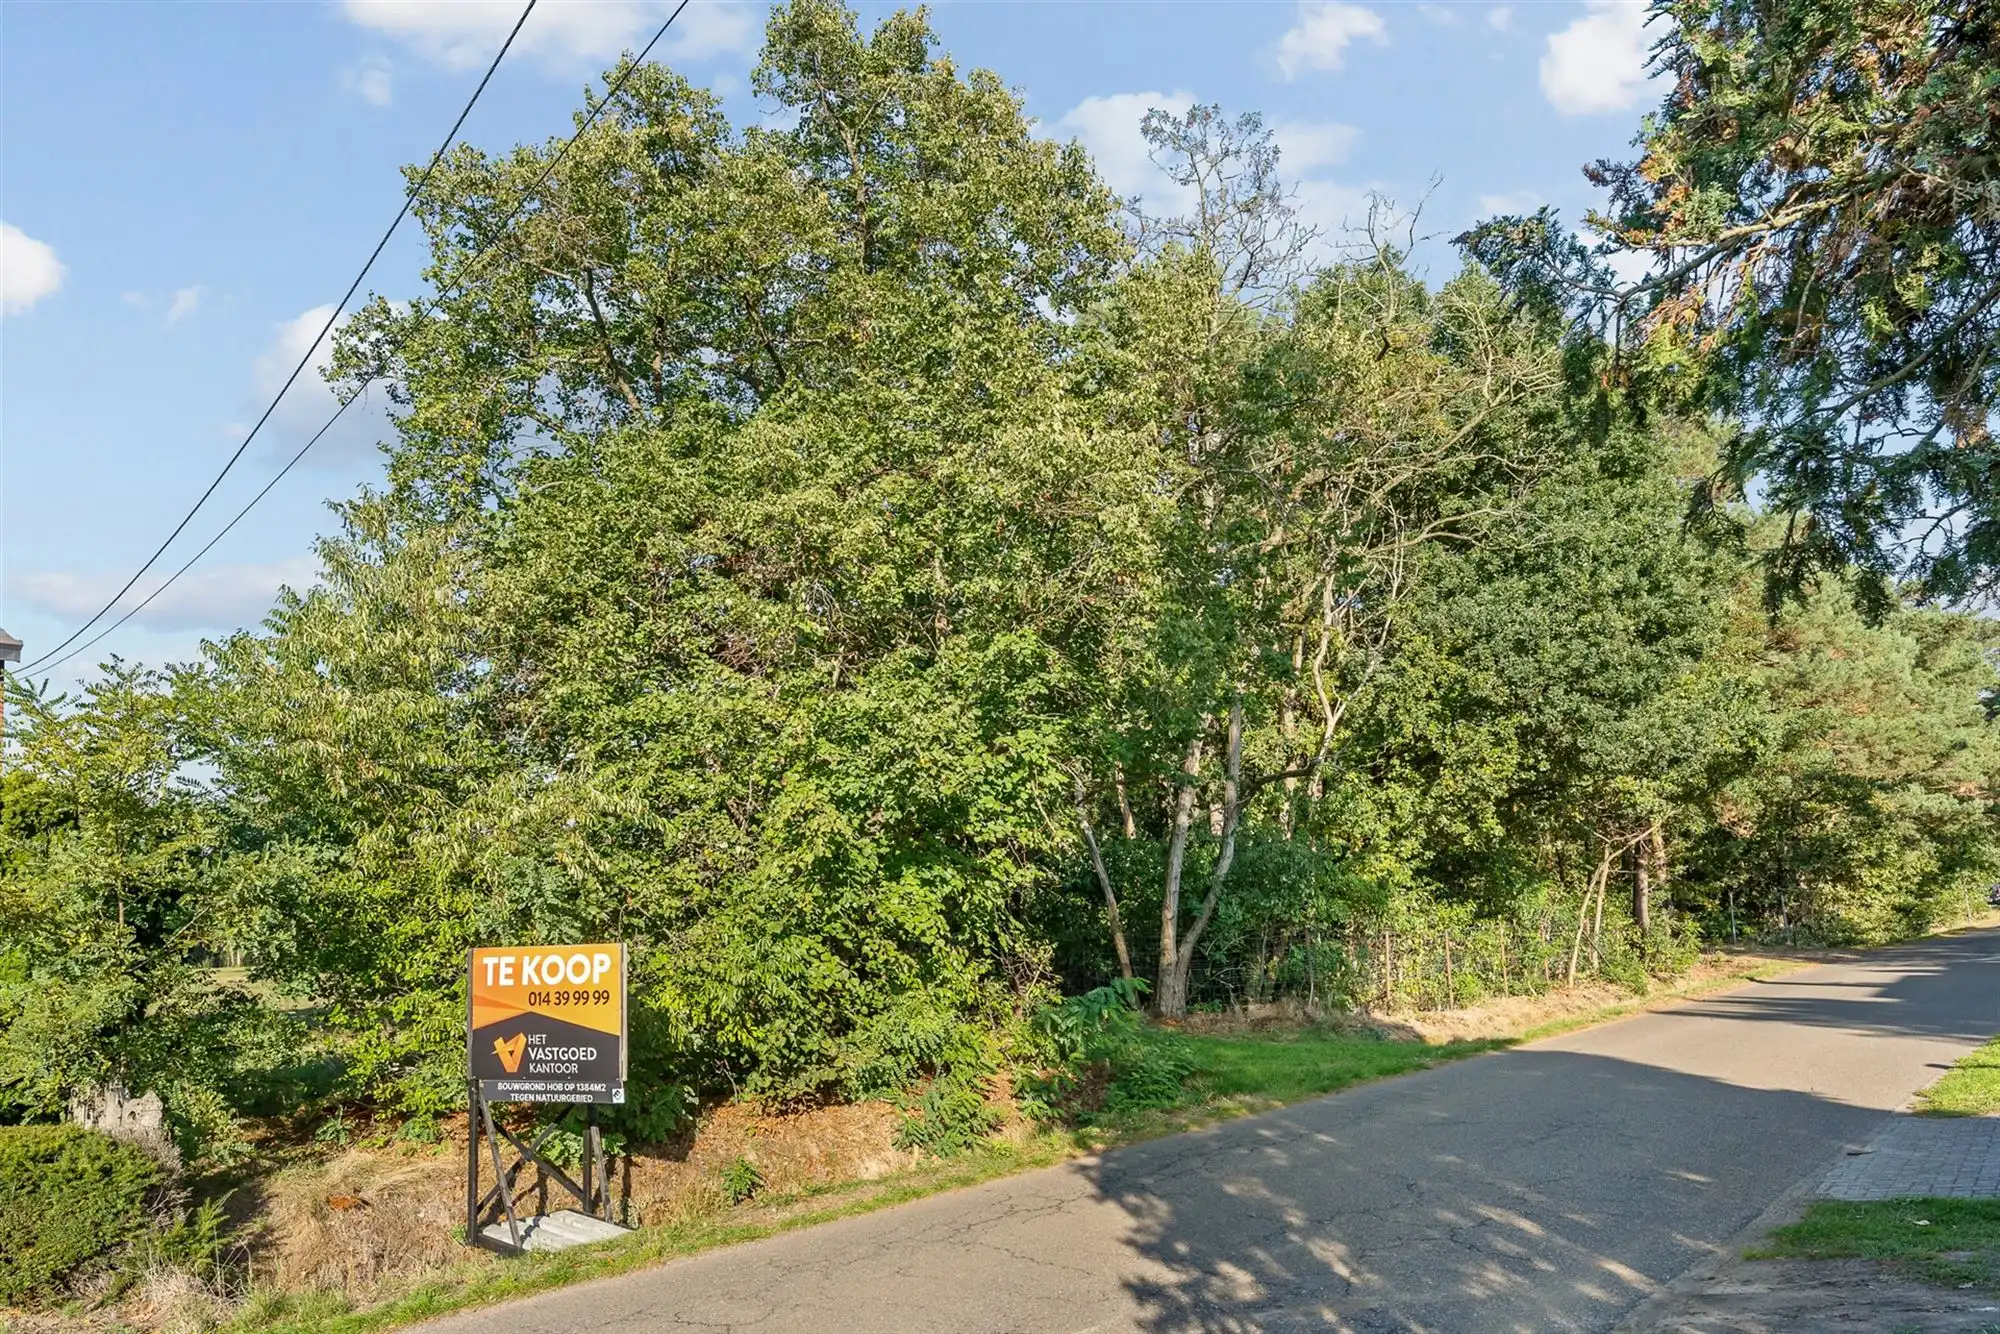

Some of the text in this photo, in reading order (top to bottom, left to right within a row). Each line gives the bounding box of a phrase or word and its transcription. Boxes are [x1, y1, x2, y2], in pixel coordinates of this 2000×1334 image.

[483, 953, 611, 986] TE KOOP
[528, 990, 610, 1006] 014 39 99 99
[528, 1034, 547, 1045] HET
[528, 1047, 597, 1061] VASTGOED
[529, 1063, 578, 1074] KANTOOR
[498, 1082, 607, 1092] BOUWGROND HOB OP 1384M2
[510, 1093, 593, 1103] TEGEN NATUURGEBIED
